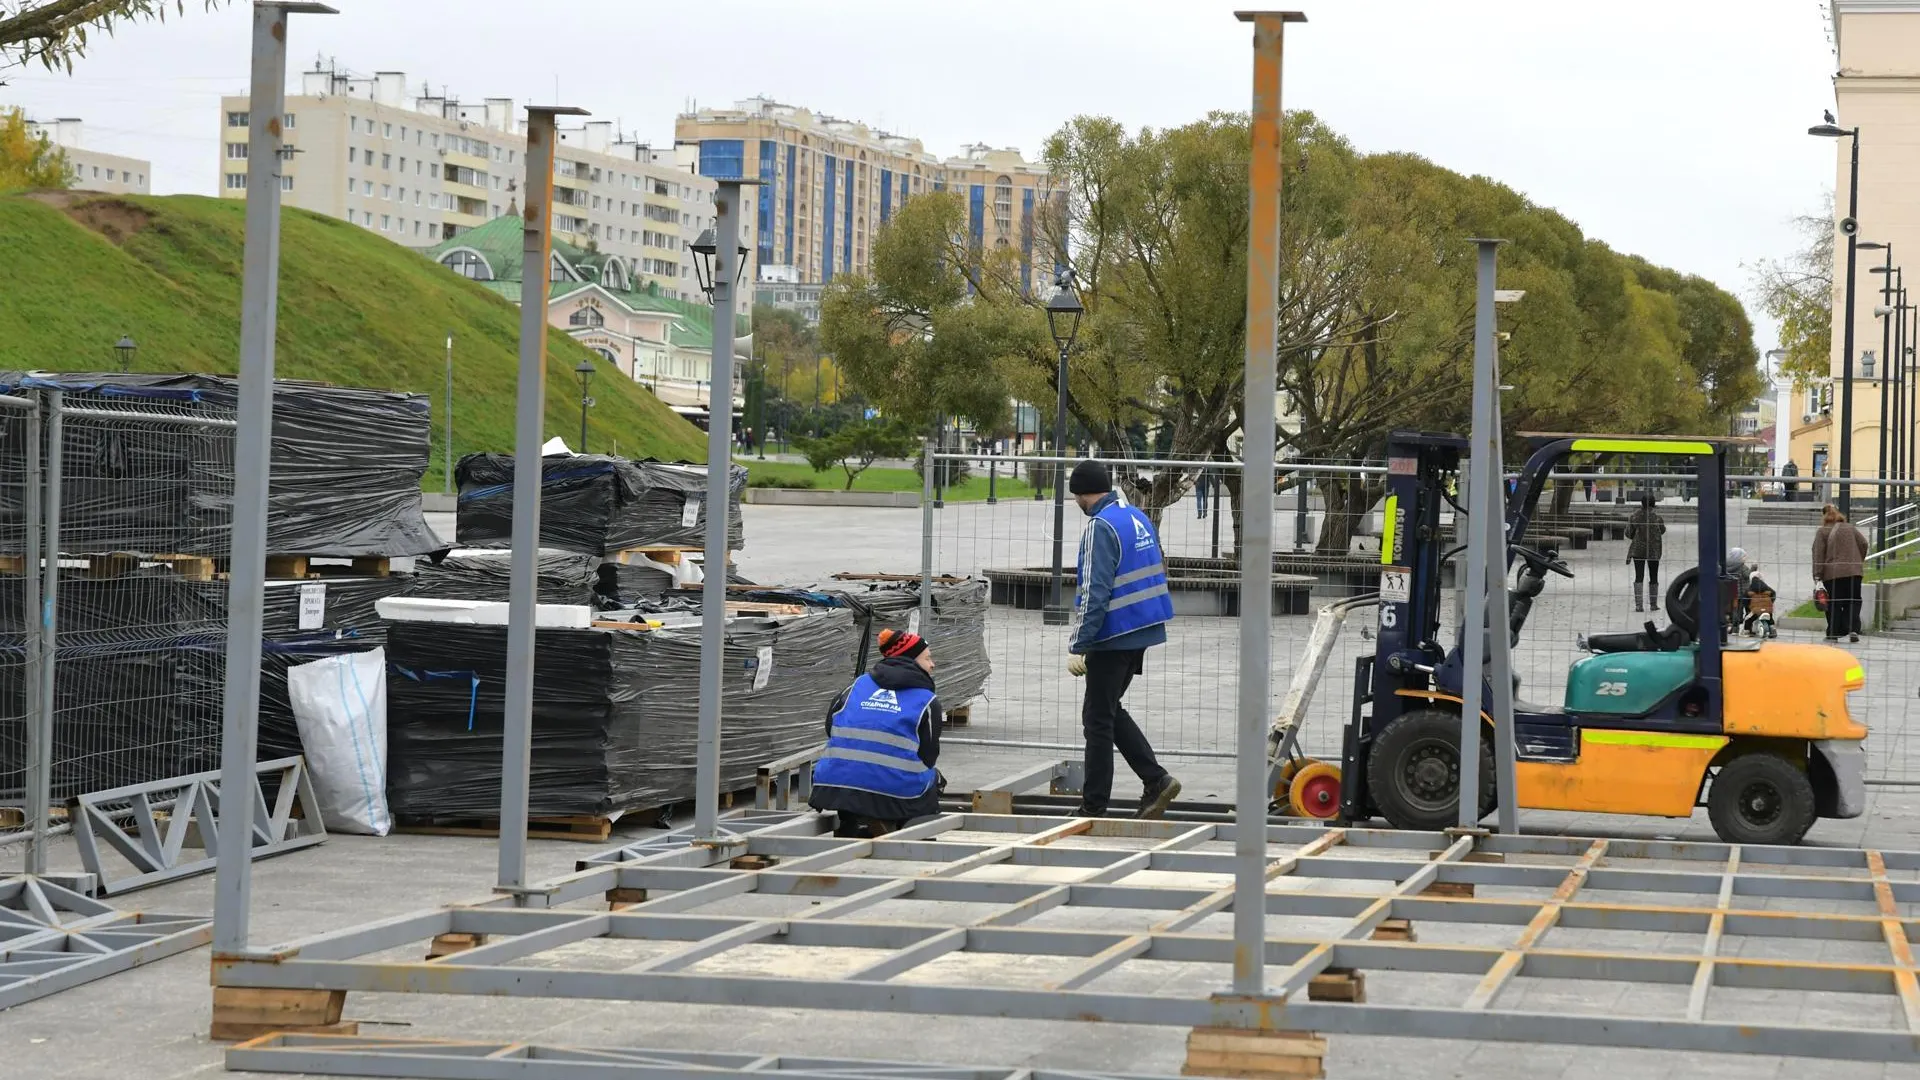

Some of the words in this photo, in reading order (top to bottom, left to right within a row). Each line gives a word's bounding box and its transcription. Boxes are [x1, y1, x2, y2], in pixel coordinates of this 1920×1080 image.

[1394, 508, 1405, 560] KOMATSU
[1381, 605, 1397, 628] 6
[1595, 682, 1628, 696] 25
